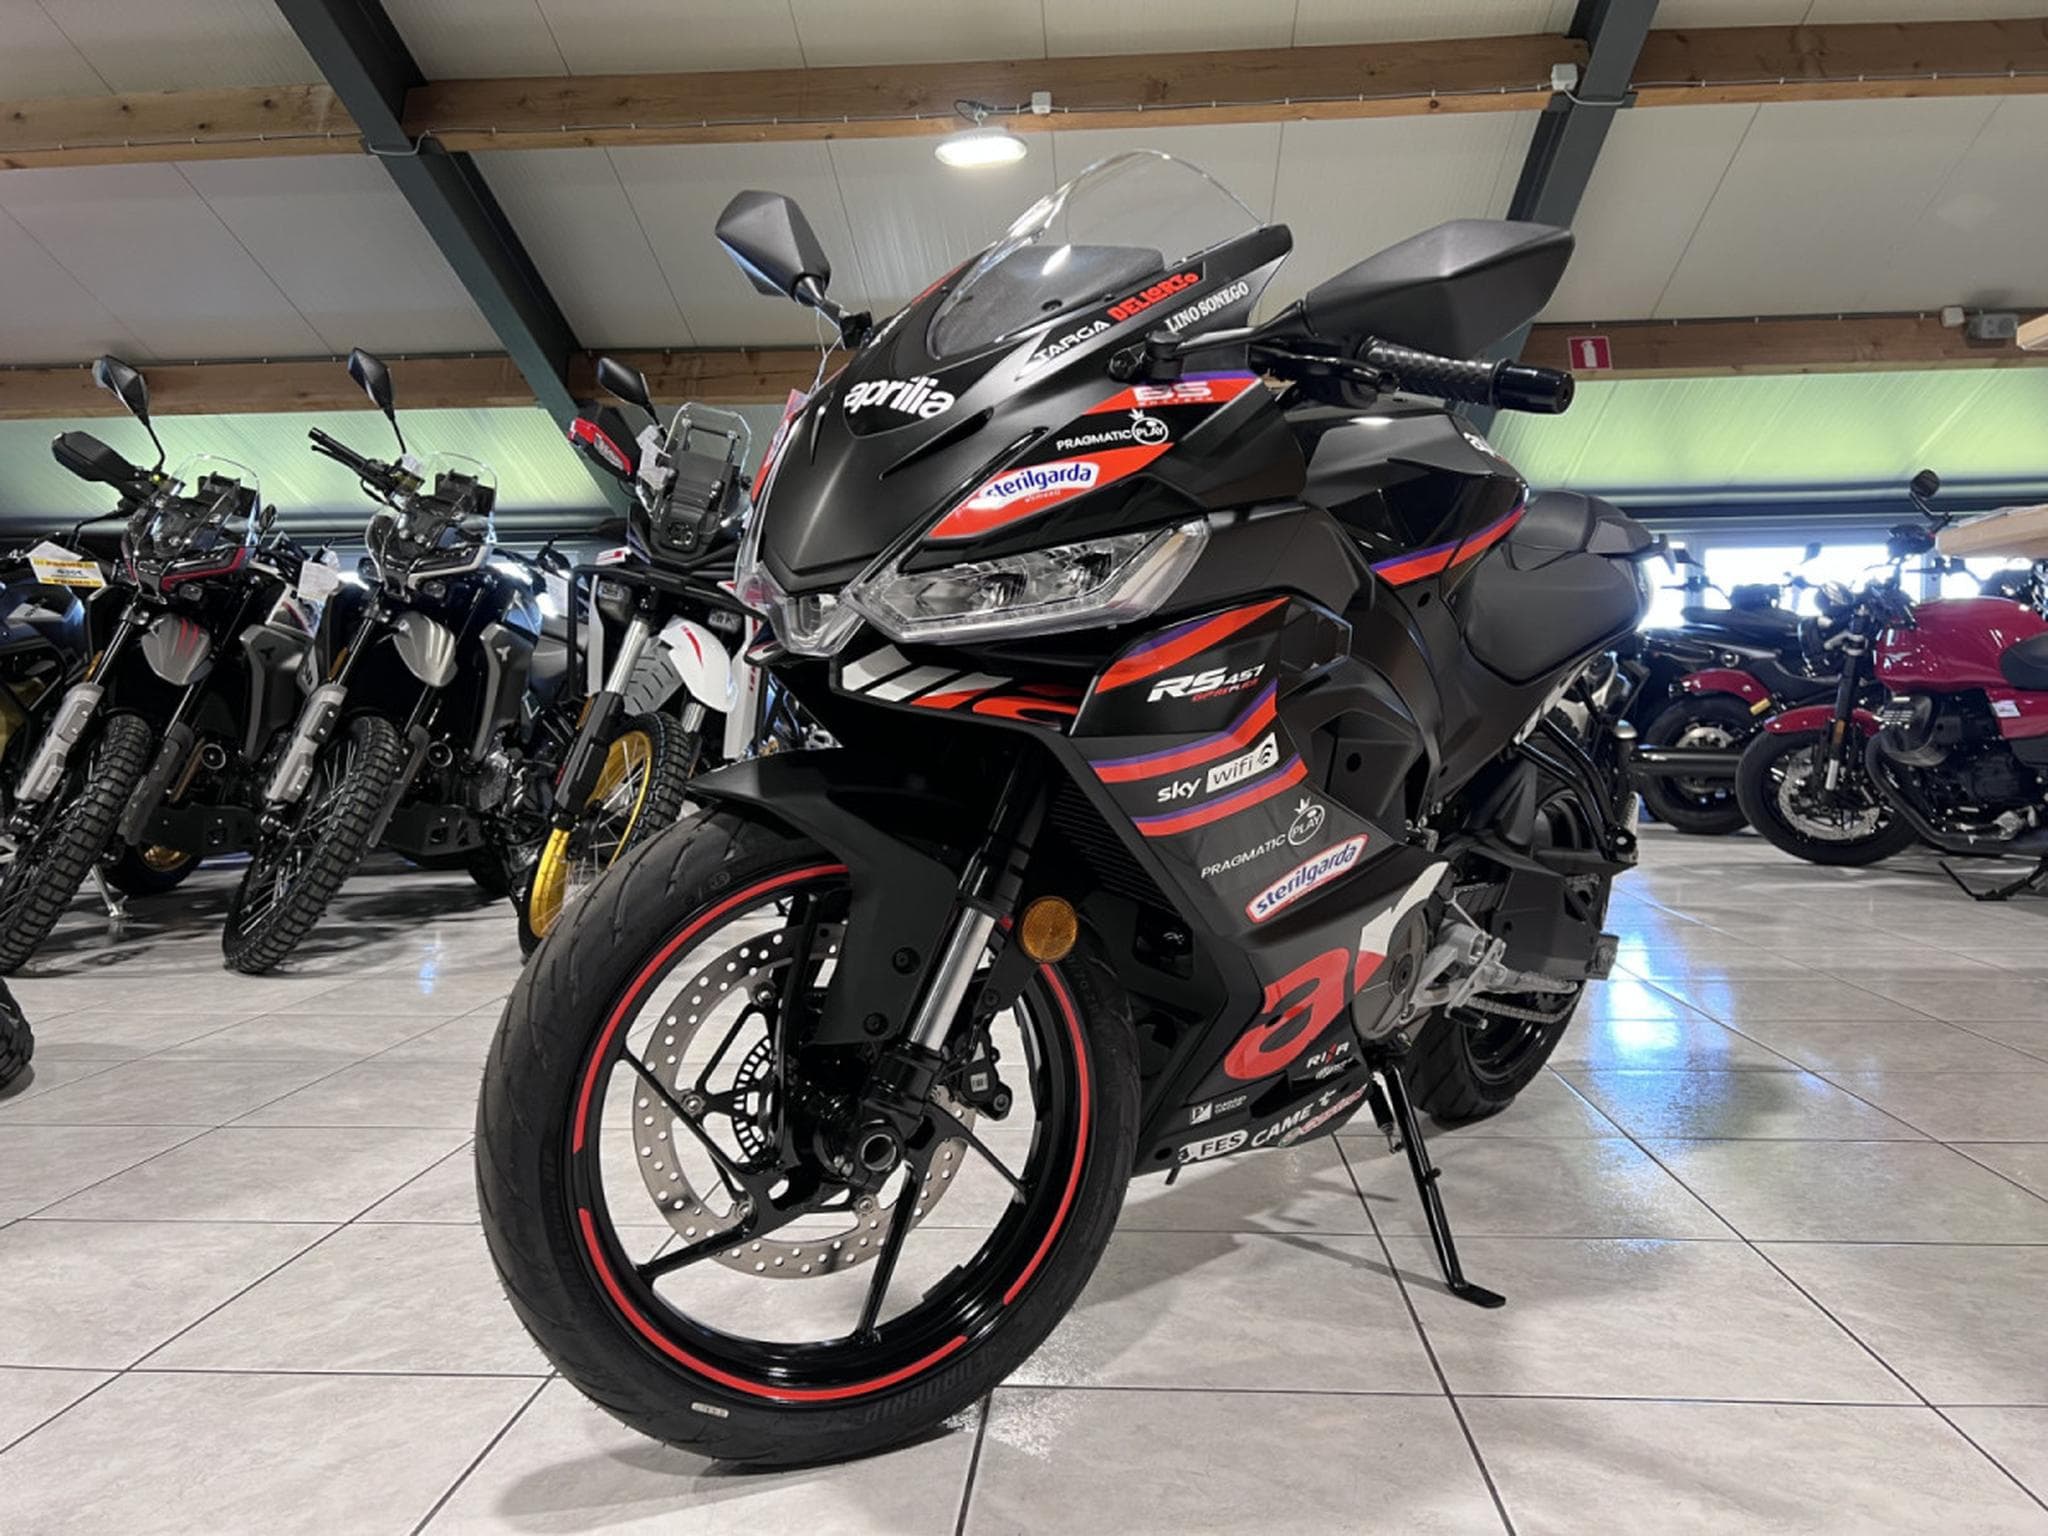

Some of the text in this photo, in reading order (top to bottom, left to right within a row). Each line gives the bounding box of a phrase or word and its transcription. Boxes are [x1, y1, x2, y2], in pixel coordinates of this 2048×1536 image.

[1164, 281, 1249, 333] LINO SONEGO
[1032, 319, 1111, 361] TARGA
[843, 376, 955, 419] aprilia
[1056, 426, 1165, 451] PRAGMATIC PLAY
[1147, 666, 1228, 702] RS
[1223, 663, 1265, 686] 457
[1157, 777, 1202, 803] sky
[1200, 813, 1321, 879] PRAGMATIC PLAY
[1256, 842, 1357, 914] sterilgarda
[1251, 1103, 1314, 1147] CAME
